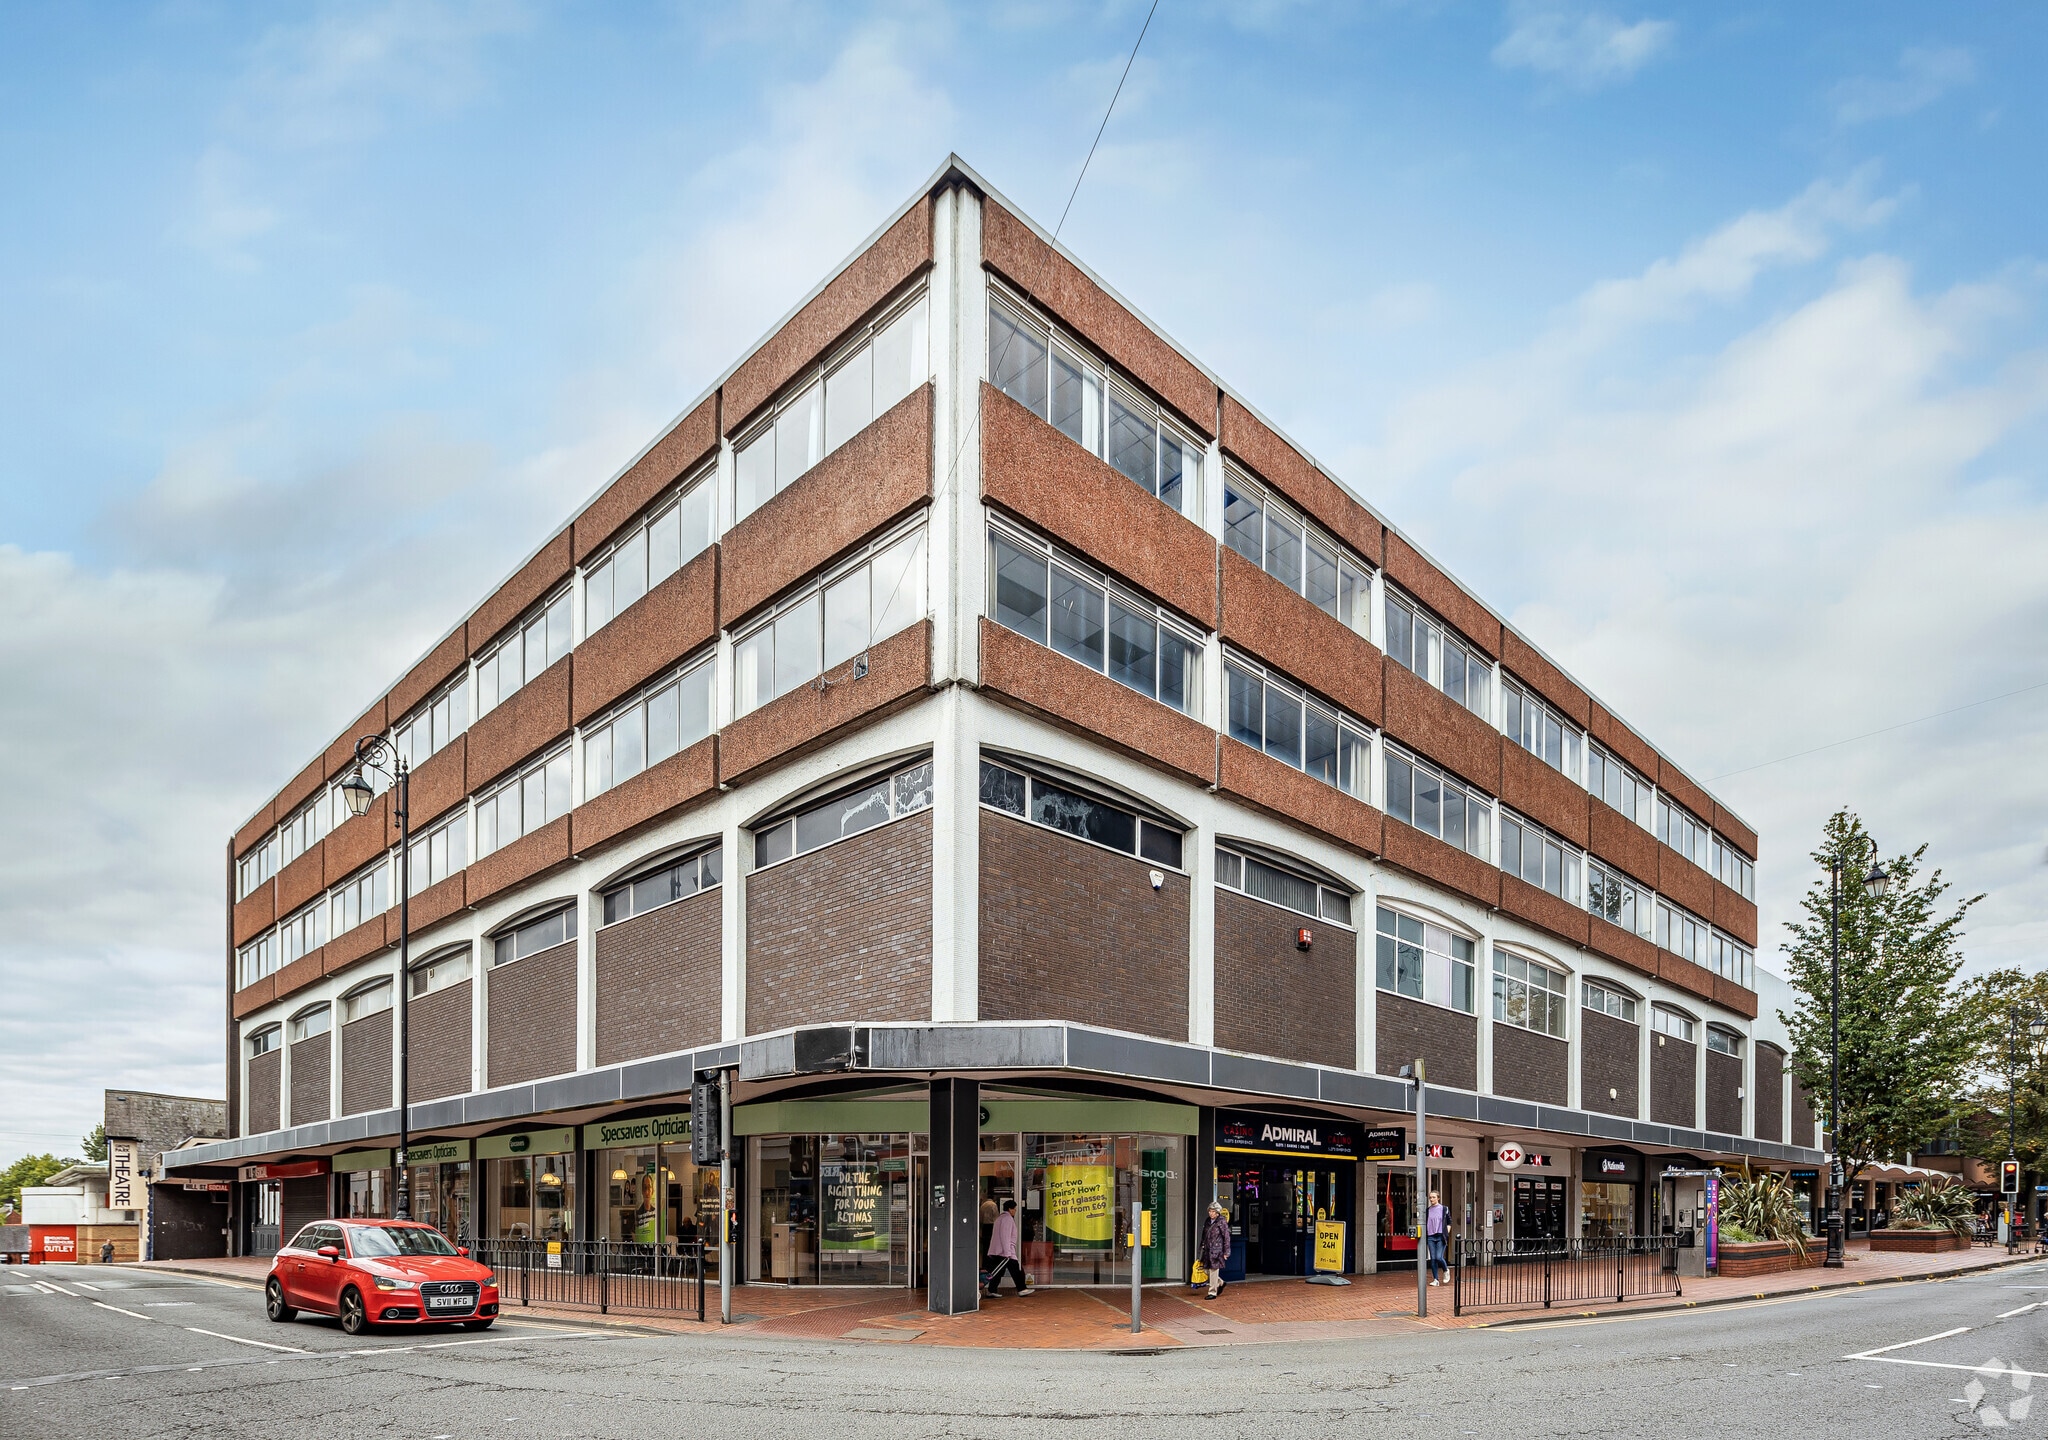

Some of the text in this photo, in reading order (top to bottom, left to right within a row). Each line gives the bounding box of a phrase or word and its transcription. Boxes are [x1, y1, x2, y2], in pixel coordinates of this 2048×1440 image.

[601, 1125, 649, 1145] Specsavers
[1223, 1125, 1254, 1137] CASINO
[1261, 1124, 1322, 1146] ADMIRAL
[1368, 1130, 1399, 1138] ADMIRAL
[407, 1148, 432, 1162] pecsavers
[433, 1145, 457, 1161] Opticians
[115, 1153, 131, 1206] THEATRE
[839, 1171, 851, 1184] DO
[852, 1171, 870, 1184] THE
[1050, 1179, 1082, 1189] For two
[827, 1185, 882, 1197] RIGHT THING
[1051, 1184, 1101, 1199] pairs? How?
[834, 1198, 876, 1211] FOR YOUR
[1052, 1199, 1060, 1207] 2
[1059, 1198, 1070, 1206] for
[1053, 1201, 1106, 1217] still from £69
[837, 1211, 872, 1224] RETINAS
[1149, 1178, 1158, 1249] Contact Lenses
[1319, 1231, 1339, 1240] OPEN
[1322, 1241, 1336, 1249] 24H
[453, 1297, 468, 1305] WFG
